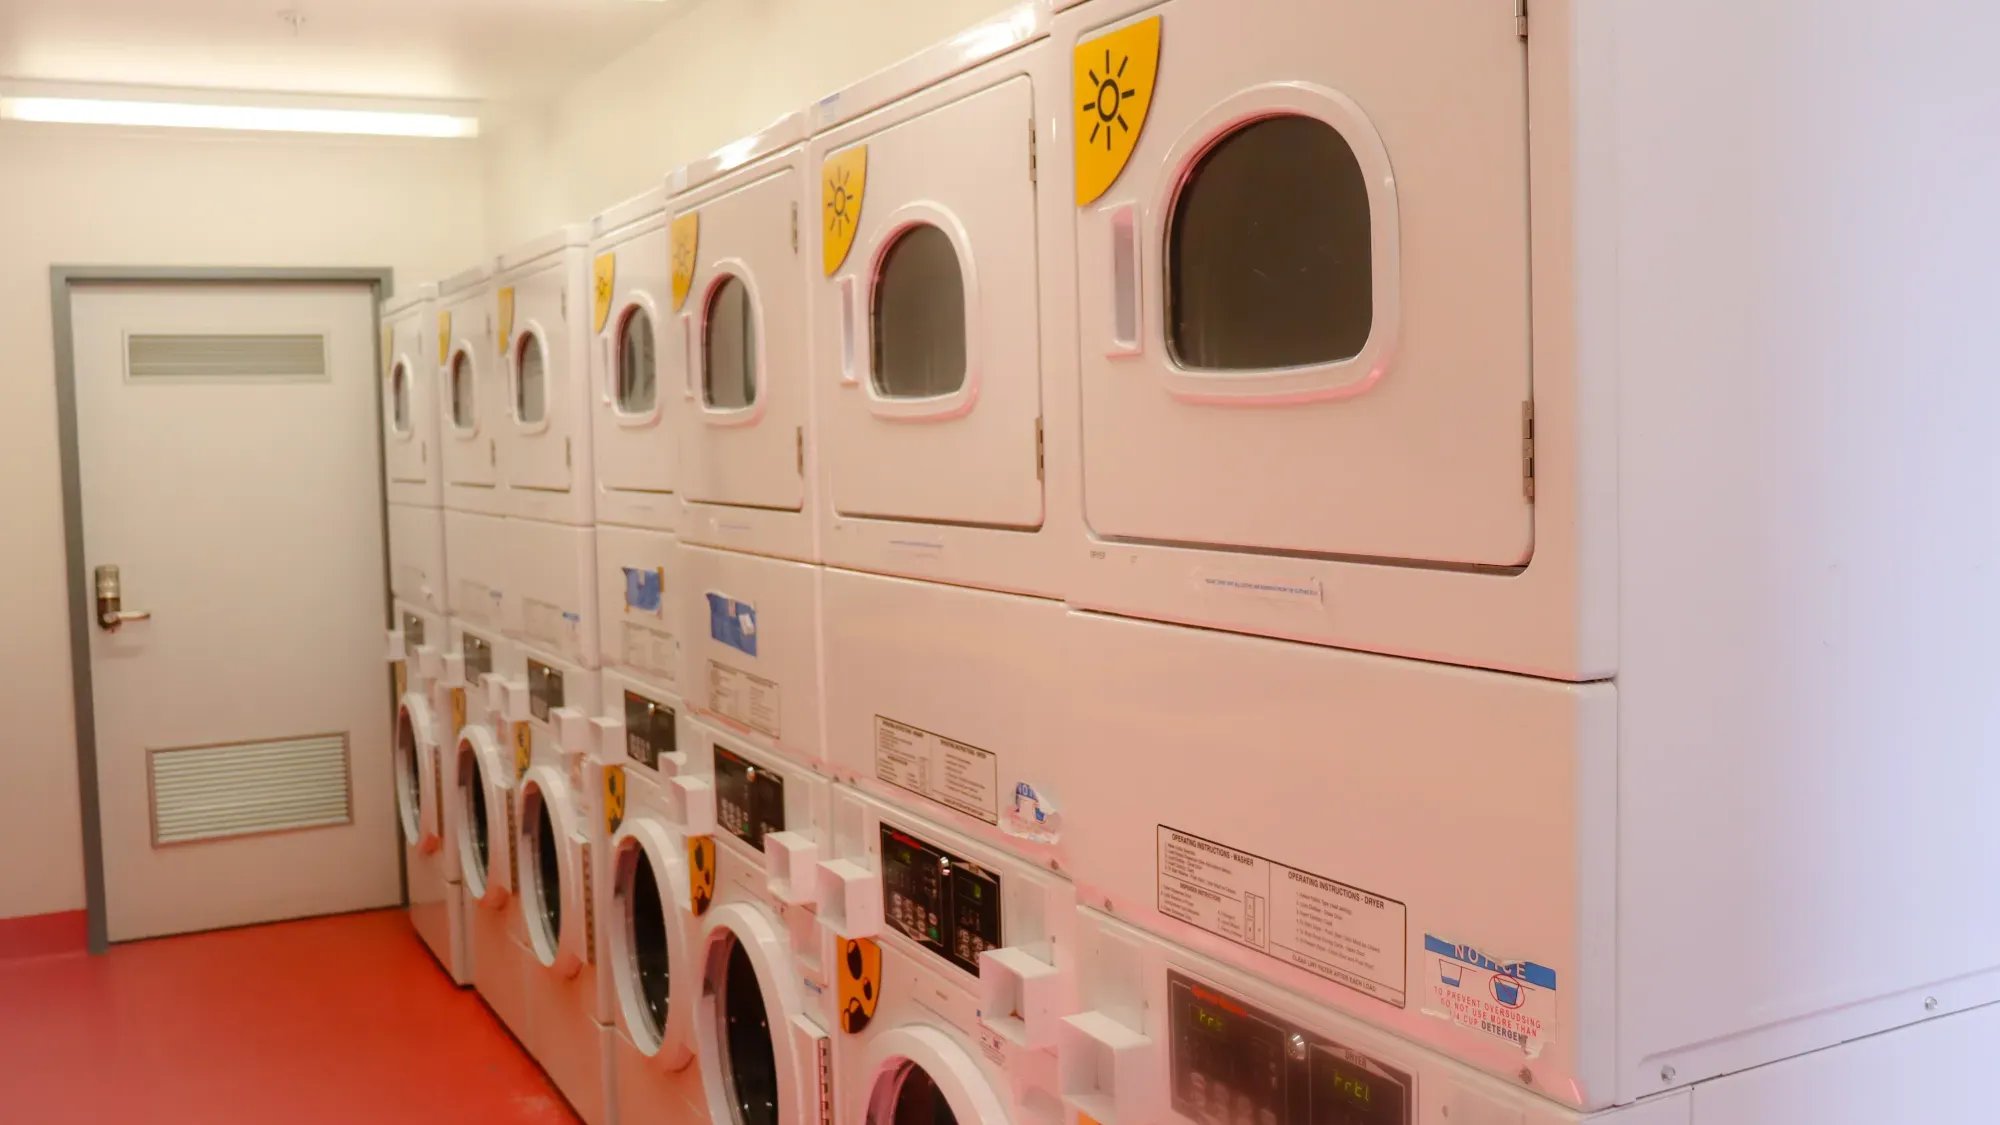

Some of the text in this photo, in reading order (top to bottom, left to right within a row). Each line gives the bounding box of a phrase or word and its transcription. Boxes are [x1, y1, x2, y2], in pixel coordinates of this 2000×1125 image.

[1172, 833, 1196, 848] OPERATING
[1197, 842, 1231, 859] INSTRUCTIONS
[1233, 854, 1254, 867] WASHER
[1288, 871, 1319, 888] OPERATING
[1319, 881, 1360, 902] INSTRUCTIONS
[1364, 896, 1385, 910] DRYER
[1434, 986, 1443, 996] TO
[1447, 991, 1481, 1007] PREVENT
[1454, 1002, 1470, 1013] NOT
[1472, 1008, 1487, 1020] USE
[1491, 1014, 1512, 1029] MORE
[1516, 1021, 1537, 1037] THAN
[1463, 1015, 1478, 1025] CUP
